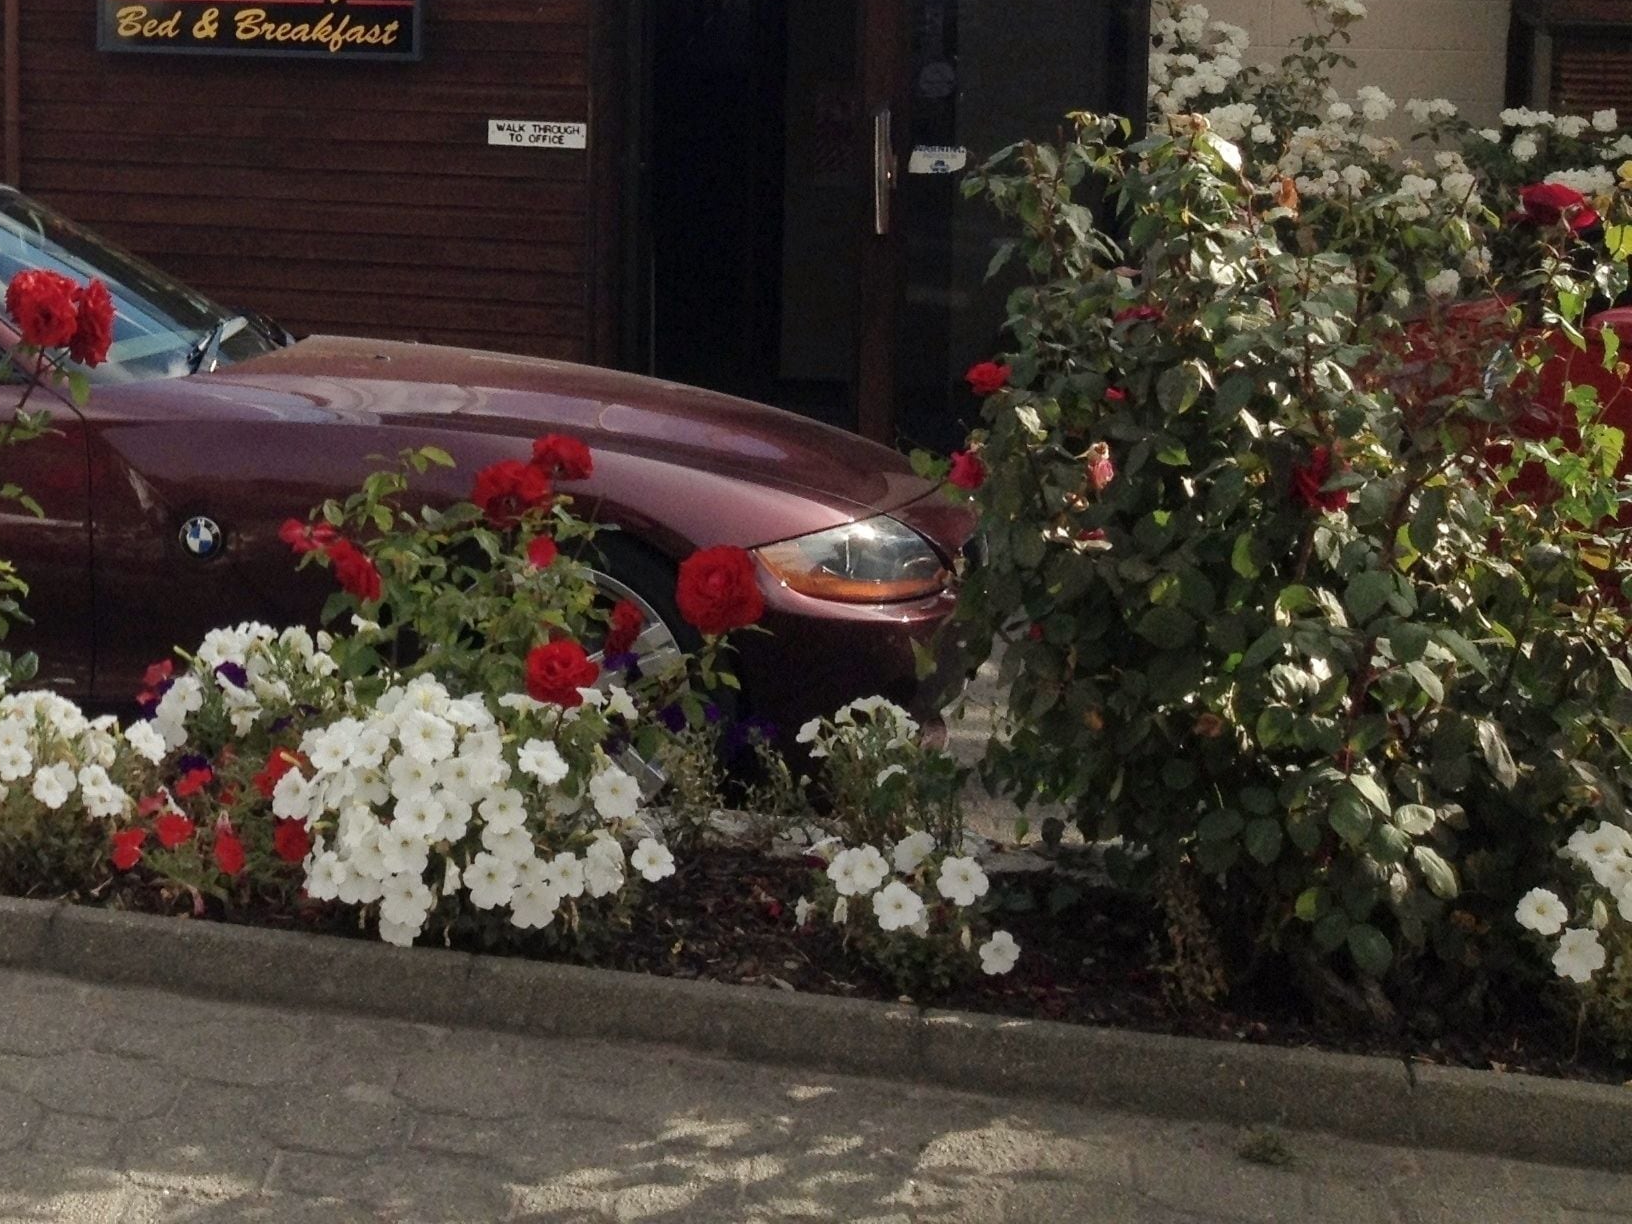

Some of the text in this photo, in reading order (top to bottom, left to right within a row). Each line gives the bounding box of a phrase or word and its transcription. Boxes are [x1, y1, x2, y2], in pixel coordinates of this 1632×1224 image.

[116, 5, 399, 52] Bed & Breakfast
[496, 123, 580, 135] WALK THROUGH
[509, 134, 565, 145] TO OFFICE
